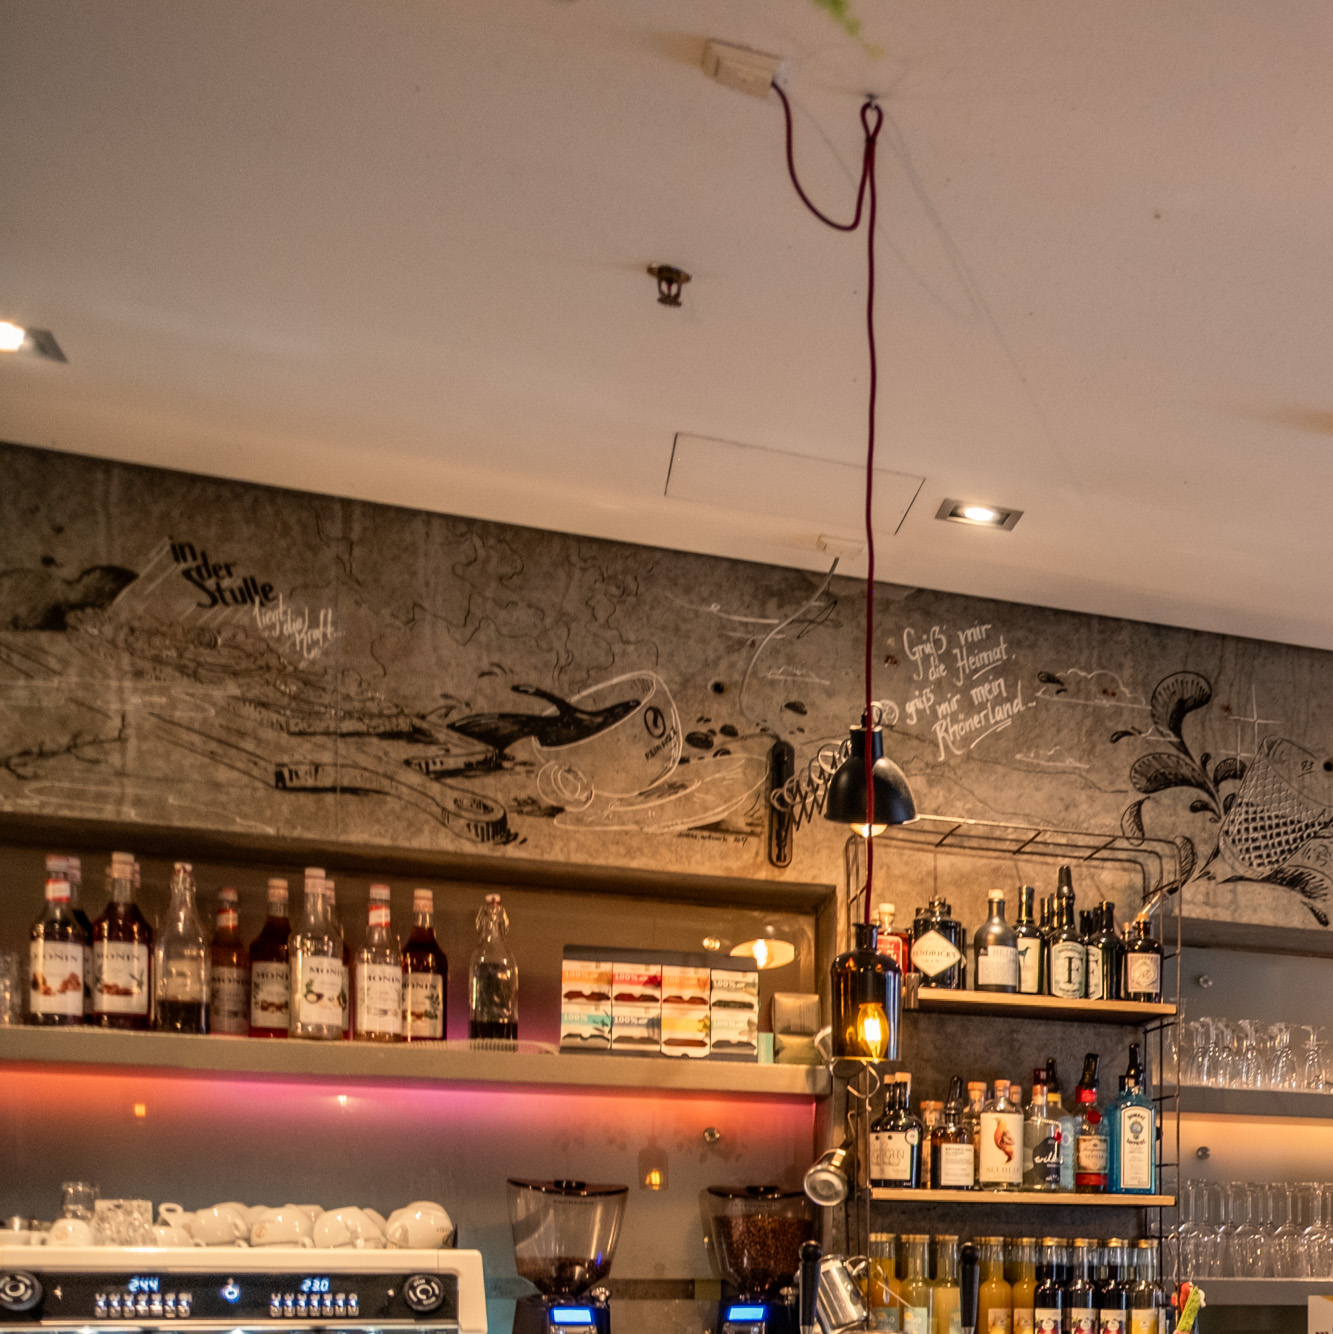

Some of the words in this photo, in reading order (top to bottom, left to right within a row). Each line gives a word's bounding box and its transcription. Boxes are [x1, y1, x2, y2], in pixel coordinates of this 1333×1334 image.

[168, 535, 198, 564] in
[181, 568, 277, 609] Stulle
[957, 620, 992, 646] mir
[928, 656, 948, 680] die
[935, 693, 961, 719] mir
[970, 676, 1008, 705] mein
